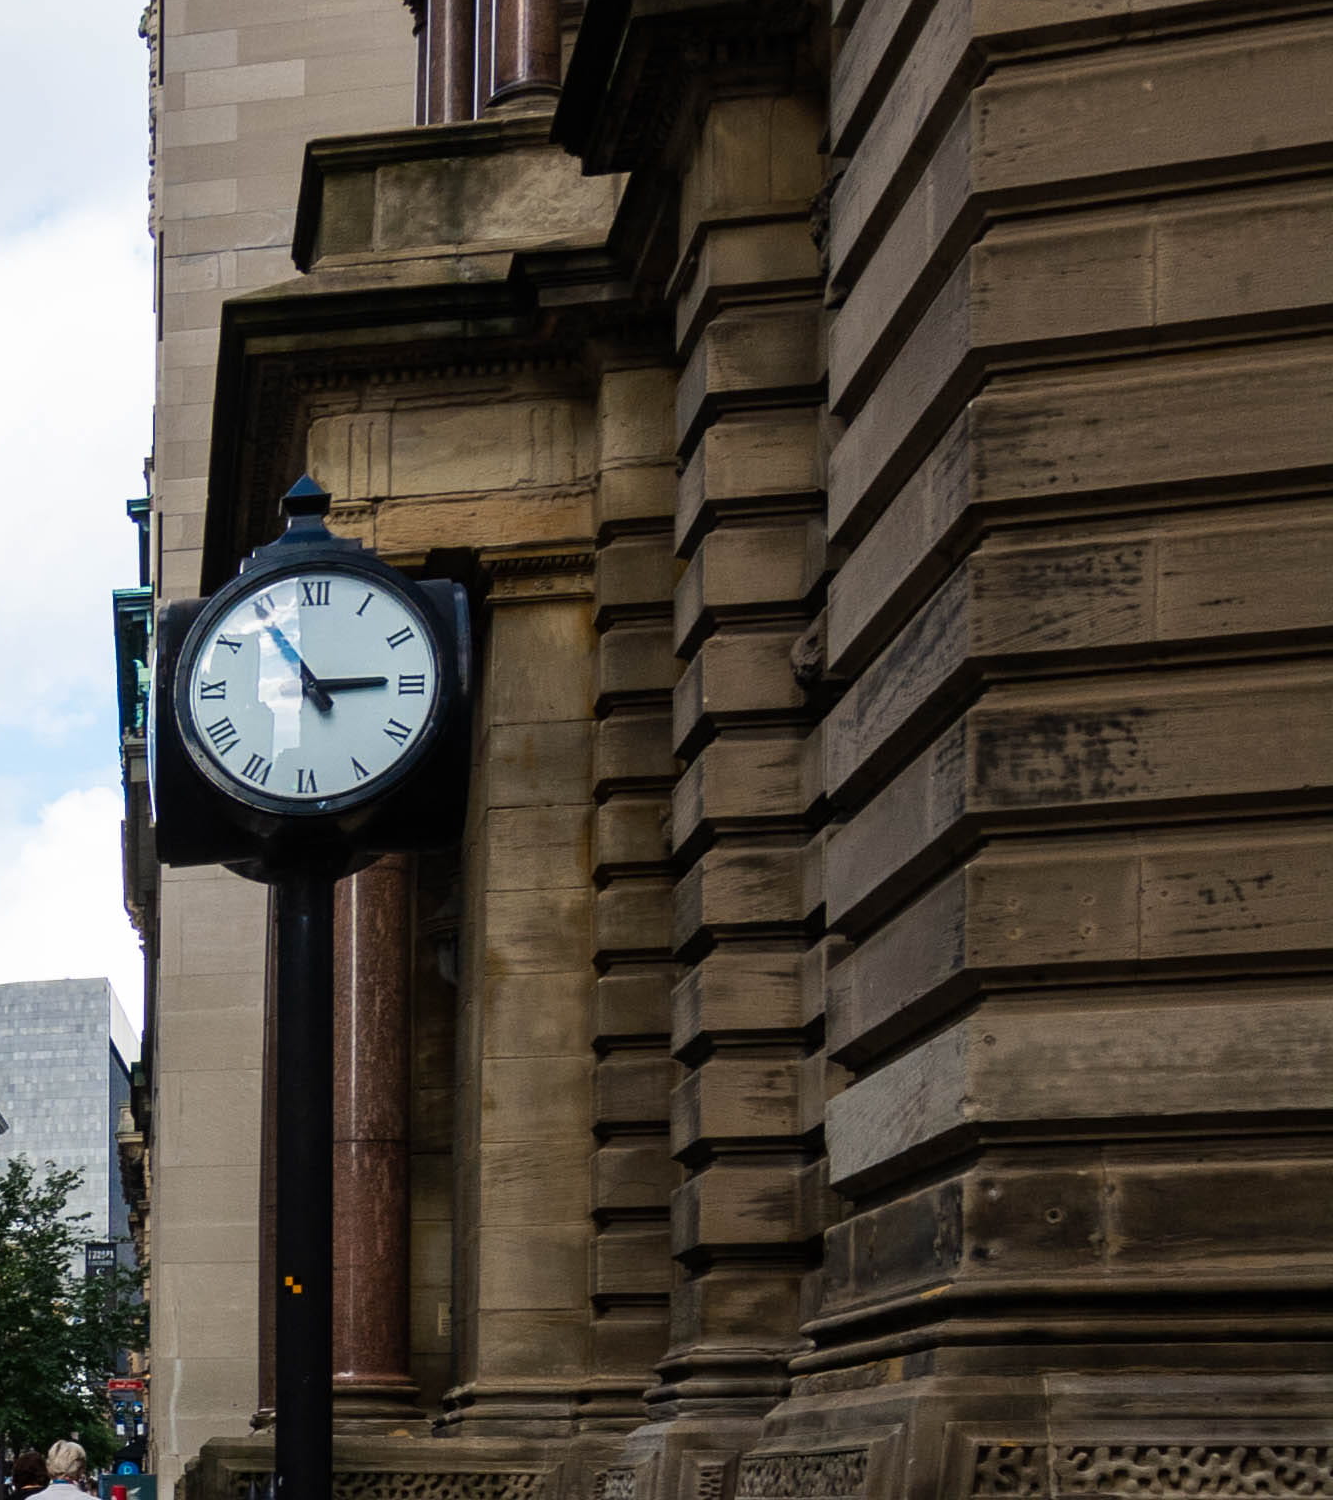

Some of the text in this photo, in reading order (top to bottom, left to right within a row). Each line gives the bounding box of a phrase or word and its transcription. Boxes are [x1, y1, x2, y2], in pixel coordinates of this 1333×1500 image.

[301, 580, 332, 607] XII
[355, 592, 375, 617] I
[216, 634, 243, 655] X
[386, 625, 415, 650] II
[200, 679, 227, 701] IX
[398, 673, 426, 696] III
[205, 716, 241, 757] VIII
[382, 718, 413, 747] IV
[241, 753, 273, 787] VII
[296, 768, 318, 794] VI
[351, 756, 370, 781] V
